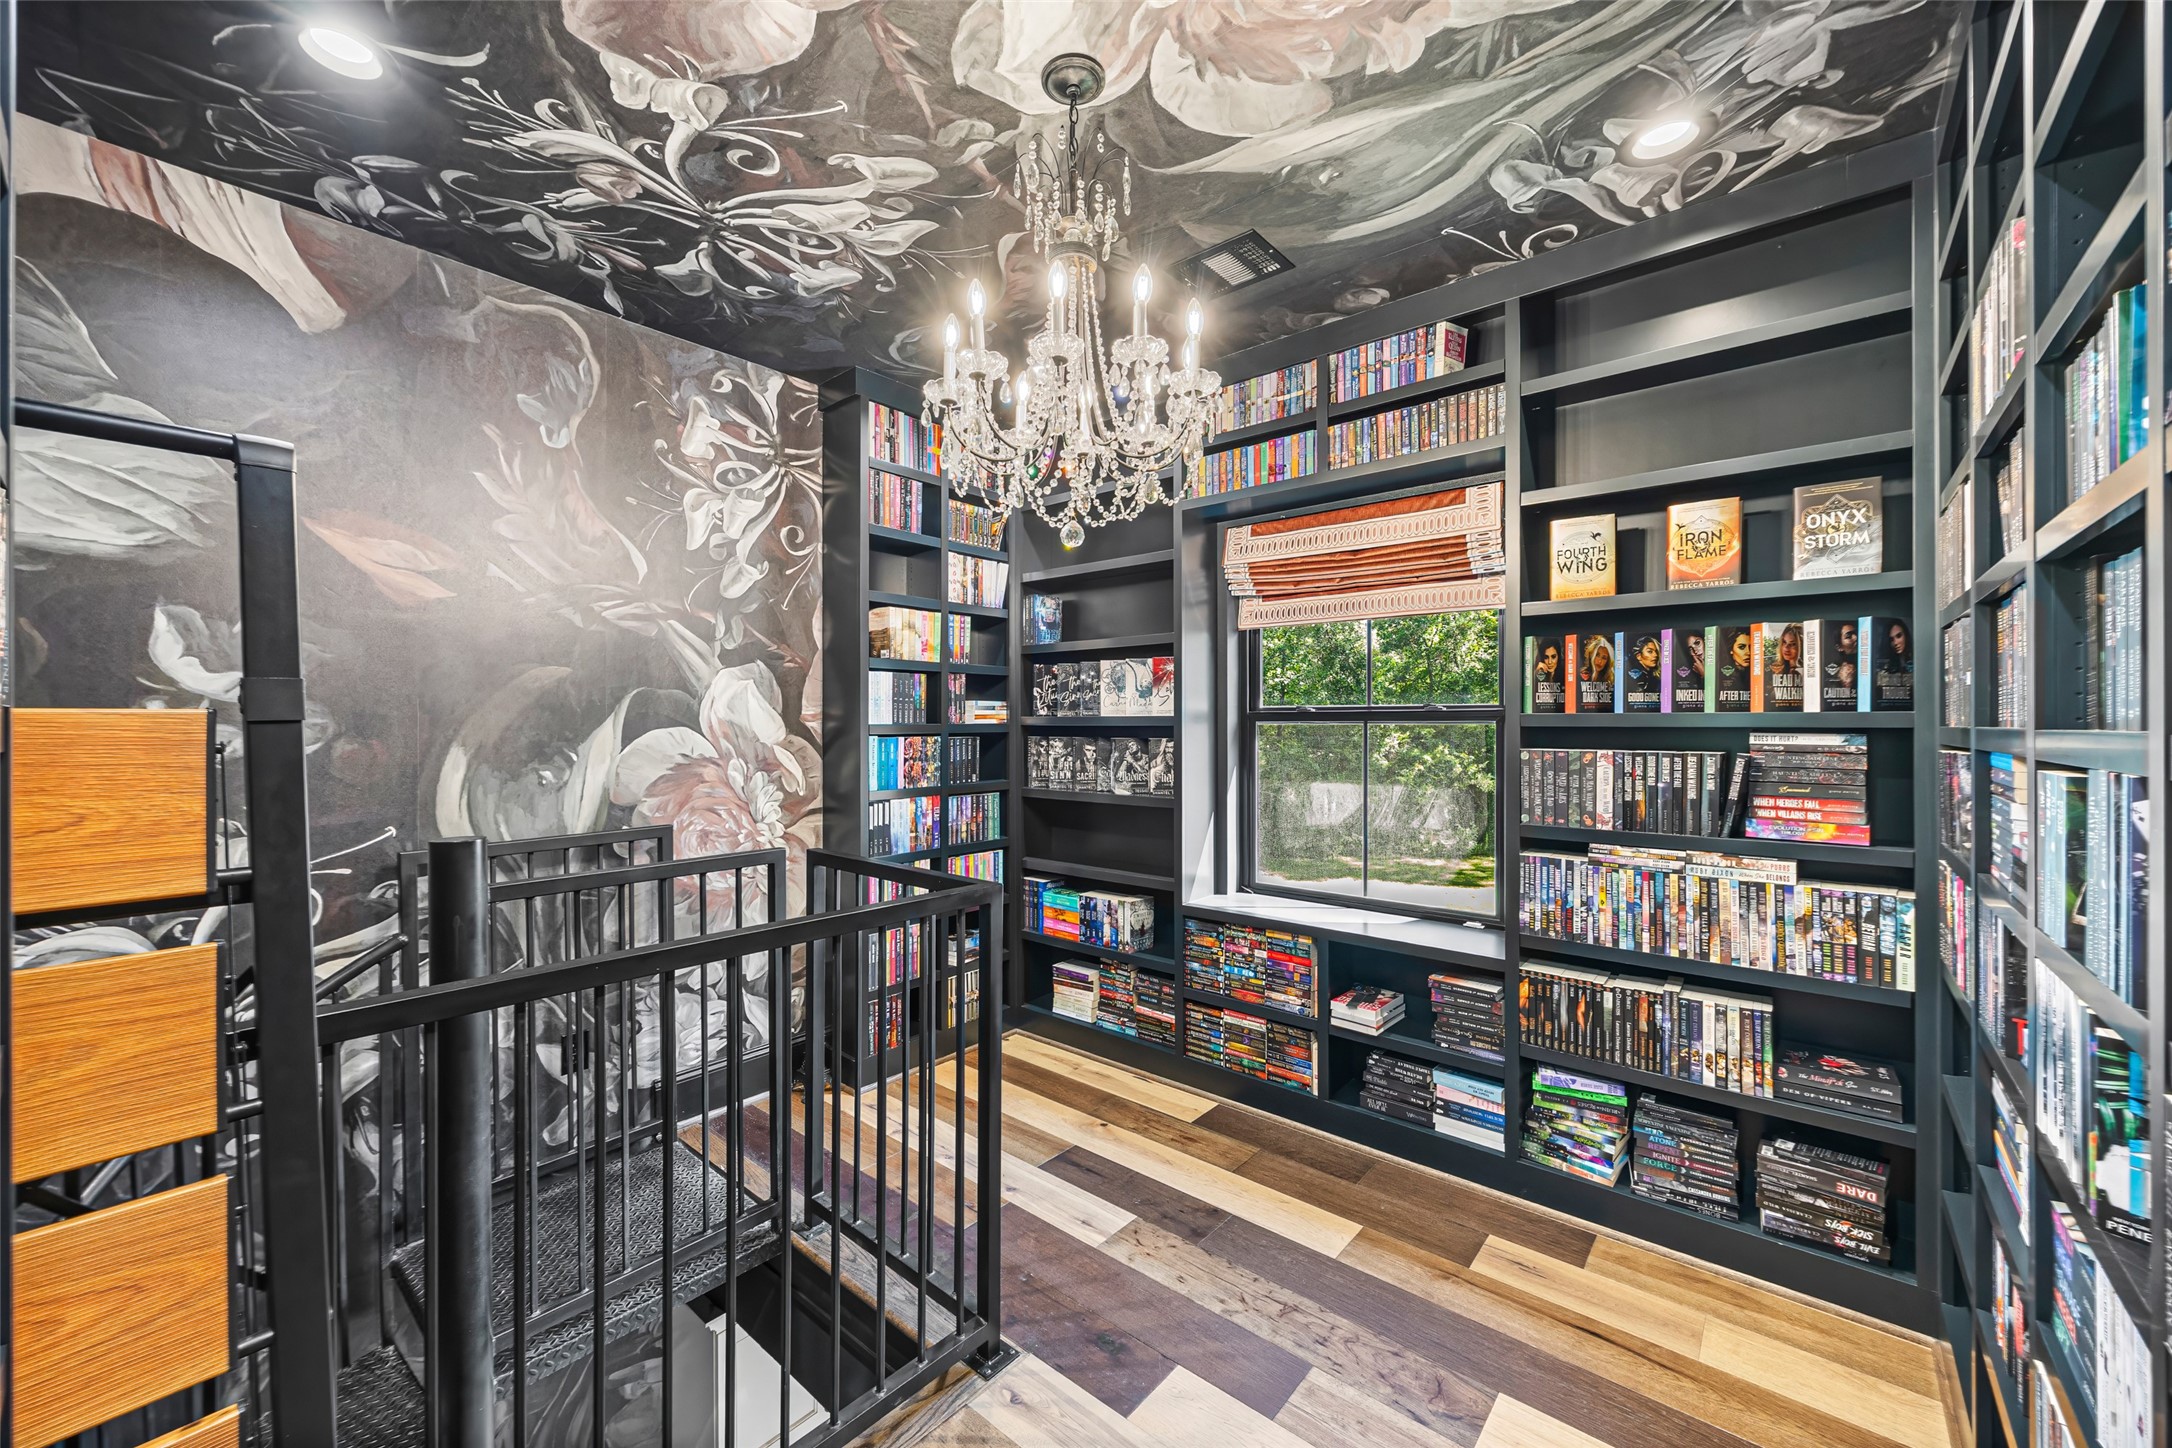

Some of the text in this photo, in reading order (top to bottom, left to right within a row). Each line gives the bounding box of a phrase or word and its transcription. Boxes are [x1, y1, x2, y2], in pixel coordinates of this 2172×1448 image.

[1806, 508, 1867, 529] ONYX
[1680, 528, 1723, 547] IRON
[1804, 530, 1871, 550] STORM
[1557, 545, 1607, 560] FOURTH
[1677, 545, 1727, 561] FLAME
[1557, 557, 1608, 574] WING
[1800, 566, 1875, 578] REBECCA YARROS
[1705, 579, 1735, 587] YARROS
[1581, 681, 1608, 691] WELCOME
[1772, 673, 1793, 686] DEAD
[1535, 692, 1565, 703] CORRUPTIO
[1582, 692, 1612, 703] DARK SIDE
[1627, 692, 1660, 703] GOOD GONE
[1676, 690, 1697, 702] INKED
[1719, 690, 1751, 701] AFTER THE
[1774, 687, 1804, 700] WALKIN
[1824, 687, 1850, 699] CAUTION
[1673, 757, 1682, 770] AFTER
[1733, 758, 1745, 774] ASKING
[1032, 770, 1049, 778] RITU
[1050, 770, 1071, 779] SINN
[1076, 772, 1096, 781] SACRI
[1673, 771, 1682, 779] THE
[1687, 756, 1696, 800] DEAD MAN WALKING
[1753, 797, 1821, 809] WHEN HEROES FALL
[1755, 809, 1823, 821] WHEN VILLAINS RISE
[1689, 866, 1708, 875] RUBY
[1711, 869, 1734, 877] DIXON
[1766, 873, 1790, 883] BELONGS
[1861, 922, 1876, 952] BETHIAH
[1899, 922, 1912, 959] KASPAR
[1823, 943, 1831, 971] RUBY DIXON
[1834, 945, 1843, 973] RUBY DIXON
[1847, 946, 1855, 974] RUBY DIXON
[1864, 956, 1873, 979] RUBY DIXON
[1884, 959, 1892, 982] RUBY DIXON
[1782, 1087, 1801, 1095] DEN
[1819, 1095, 1852, 1106] VIPERS
[1649, 1136, 1677, 1148] ATONE
[1680, 1137, 1709, 1148] CASSANDRA
[1648, 1143, 1681, 1155] REPENT
[1653, 1152, 1681, 1164] IGNITE
[1643, 1158, 1677, 1172] FORCE
[1836, 1182, 1877, 1202] DARE
[1697, 1207, 1721, 1218] BONES
[1763, 1200, 1874, 1241] SICK BOYS CLARISSA WILD
[1790, 1225, 1820, 1237] CLARISSA
[2106, 1220, 2153, 1243] PENE
[1833, 1235, 1857, 1250] BOYS
[1859, 1241, 1881, 1255] EVIL
